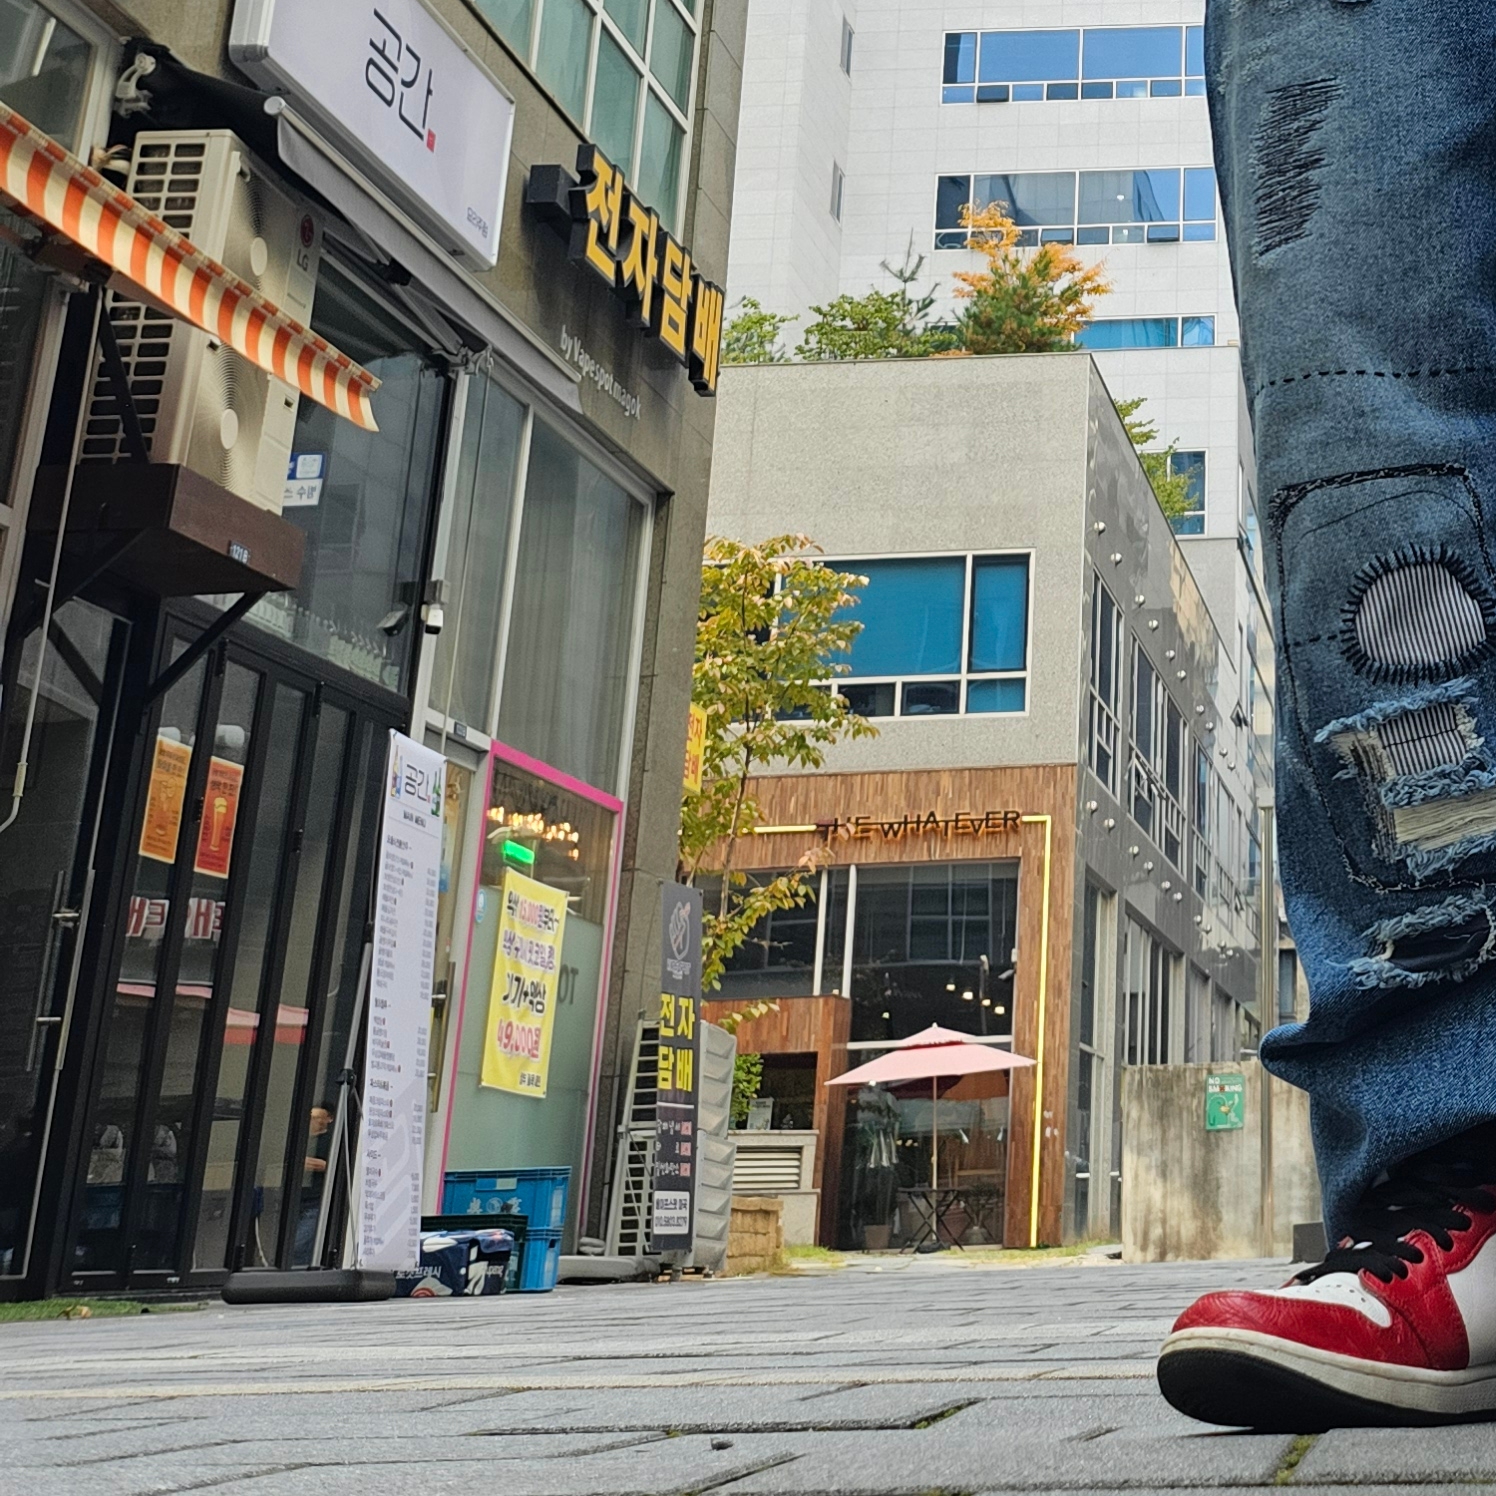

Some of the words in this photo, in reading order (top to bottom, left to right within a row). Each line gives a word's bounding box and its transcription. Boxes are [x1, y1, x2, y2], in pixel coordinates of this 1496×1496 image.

[297, 246, 309, 273] LG
[585, 149, 724, 392] 전자담배
[560, 324, 573, 361] by
[612, 381, 641, 421] magok
[880, 810, 1021, 839] WHATEVER
[659, 992, 696, 1041] 전자
[657, 1045, 694, 1092] 담배
[1208, 1077, 1220, 1085] NO
